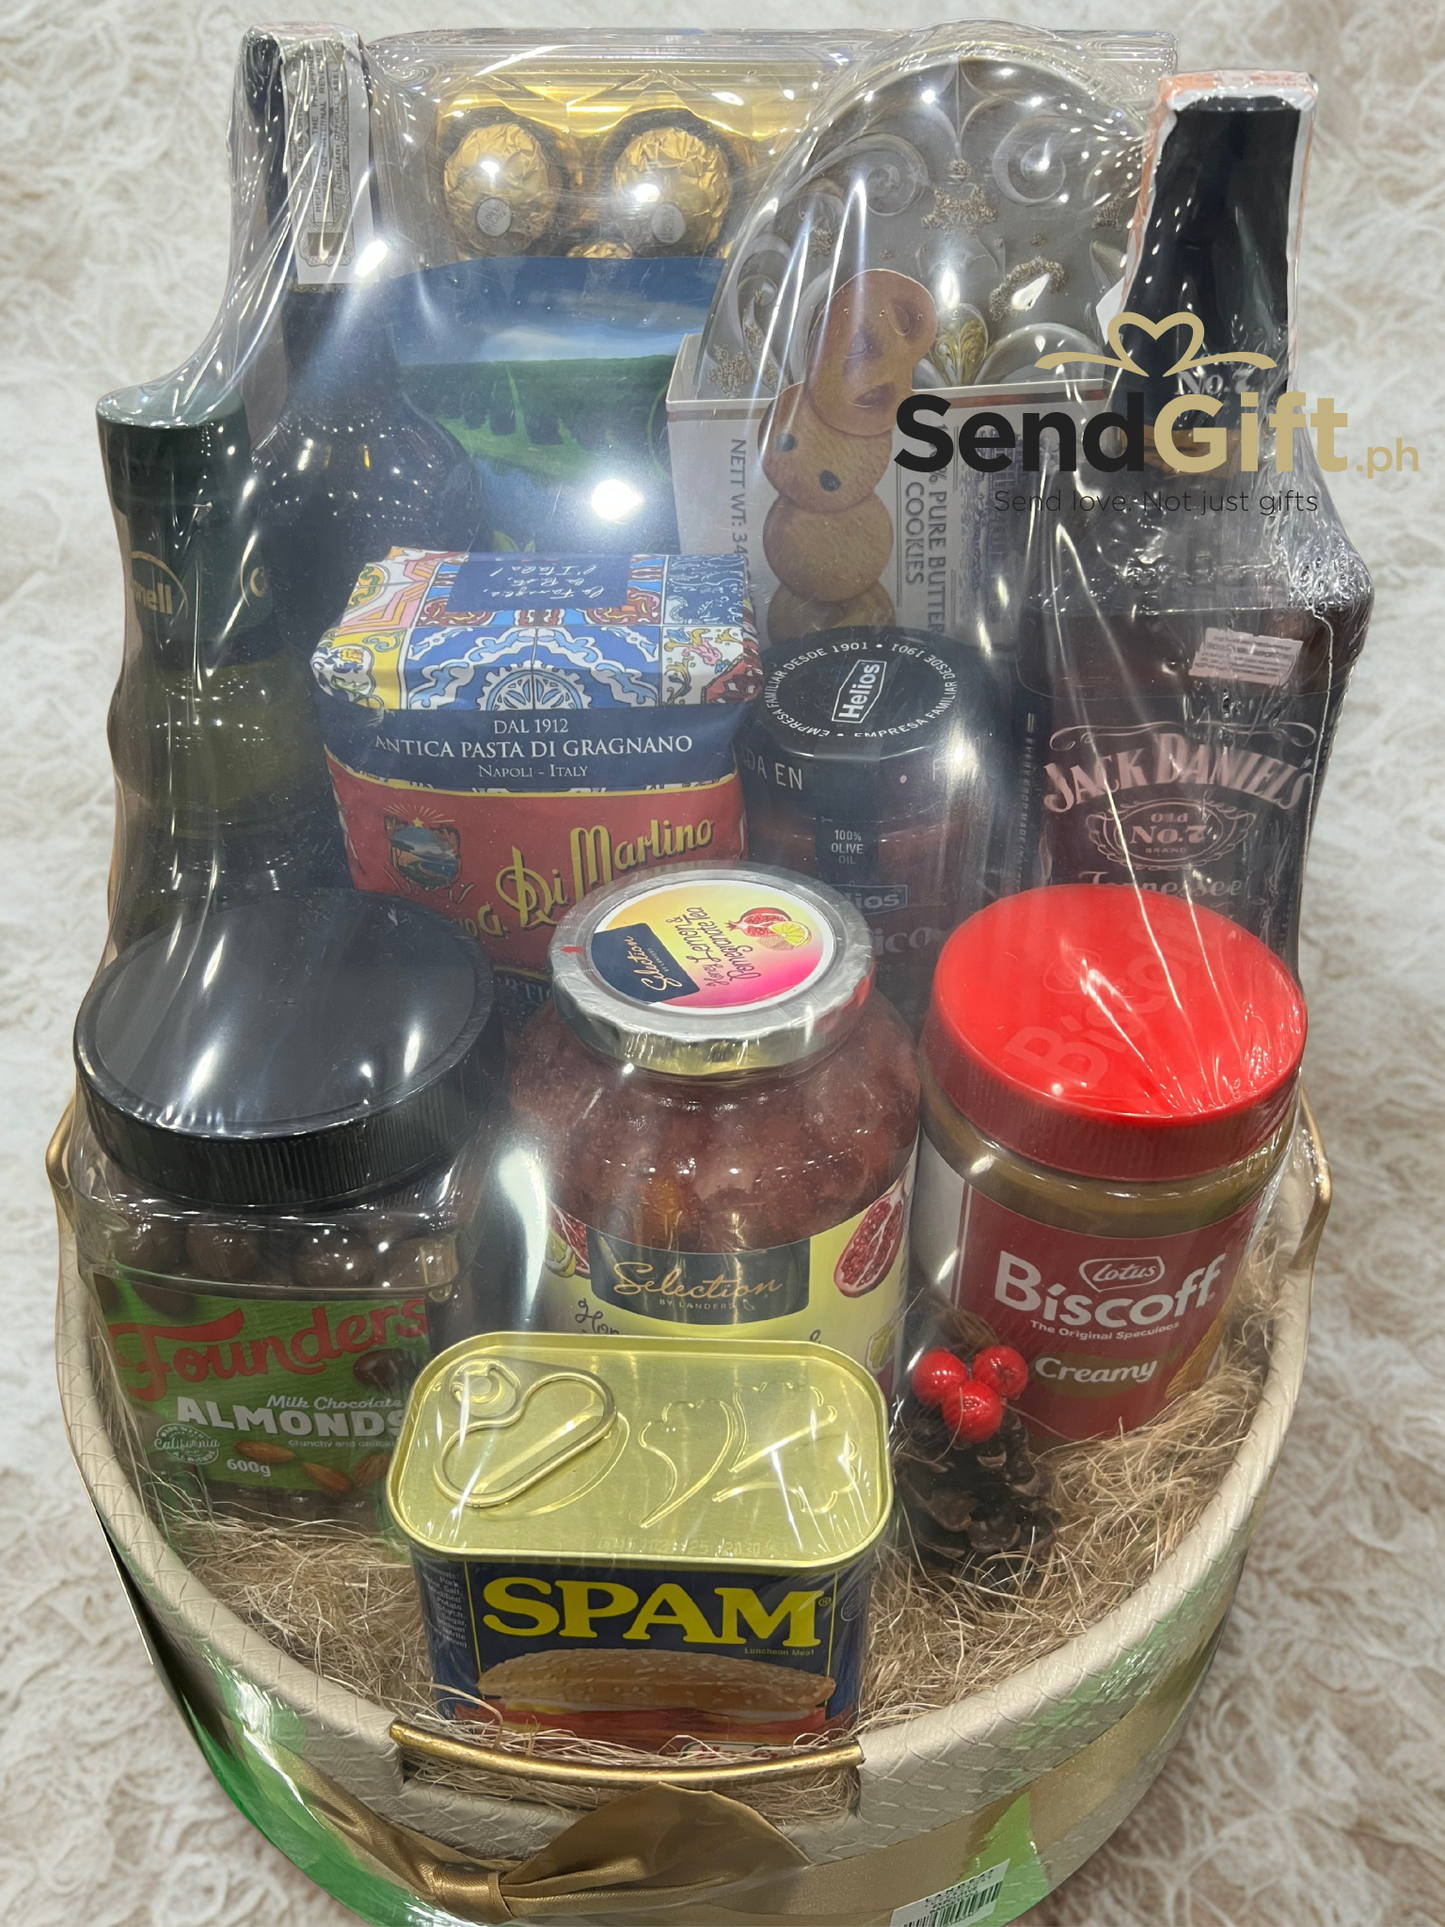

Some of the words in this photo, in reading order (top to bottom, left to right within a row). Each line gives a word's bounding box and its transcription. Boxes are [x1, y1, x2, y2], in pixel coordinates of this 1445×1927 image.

[730, 439, 747, 490] NETT
[731, 493, 747, 527] WT:
[928, 490, 947, 550] PURE
[904, 482, 926, 586] COOKIES
[927, 557, 947, 634] BUTTER
[783, 648, 828, 671] DESDE
[832, 642, 869, 653] 1901
[891, 643, 925, 658] 1901
[923, 654, 956, 680] DESDE
[764, 668, 788, 709] FAMILIAR
[838, 663, 881, 719] Helios
[925, 680, 958, 719] FAMILIAR
[494, 719, 530, 735] DAL
[533, 718, 570, 734] 1912
[772, 709, 831, 738] EMPRESA
[375, 735, 455, 759] ANTICA
[461, 739, 527, 759] PASTA
[531, 740, 556, 758] DI
[562, 735, 693, 757] GRAGNANO
[1043, 747, 1148, 813] JACK
[831, 843, 864, 855] OLIVE
[834, 829, 862, 842] 100%
[838, 856, 856, 865] OIL
[675, 919, 722, 963] Lemon
[613, 1261, 785, 1298] Selection
[994, 1250, 1227, 1328] Biscoff
[1030, 1319, 1055, 1333] The
[1058, 1327, 1113, 1341] Original
[1115, 1321, 1180, 1340] Speculoos
[107, 1298, 428, 1401] Founders
[1035, 1356, 1158, 1383] Creamy
[266, 1395, 310, 1409] Milk
[313, 1396, 404, 1411] Chocolate
[154, 1437, 220, 1451] California
[288, 1440, 332, 1448] crunchy
[335, 1439, 356, 1448] and
[226, 1458, 272, 1478] 600g
[482, 1576, 824, 1648] SPAM
[744, 1647, 789, 1656] Luncheon
[792, 1648, 816, 1656] Meat
